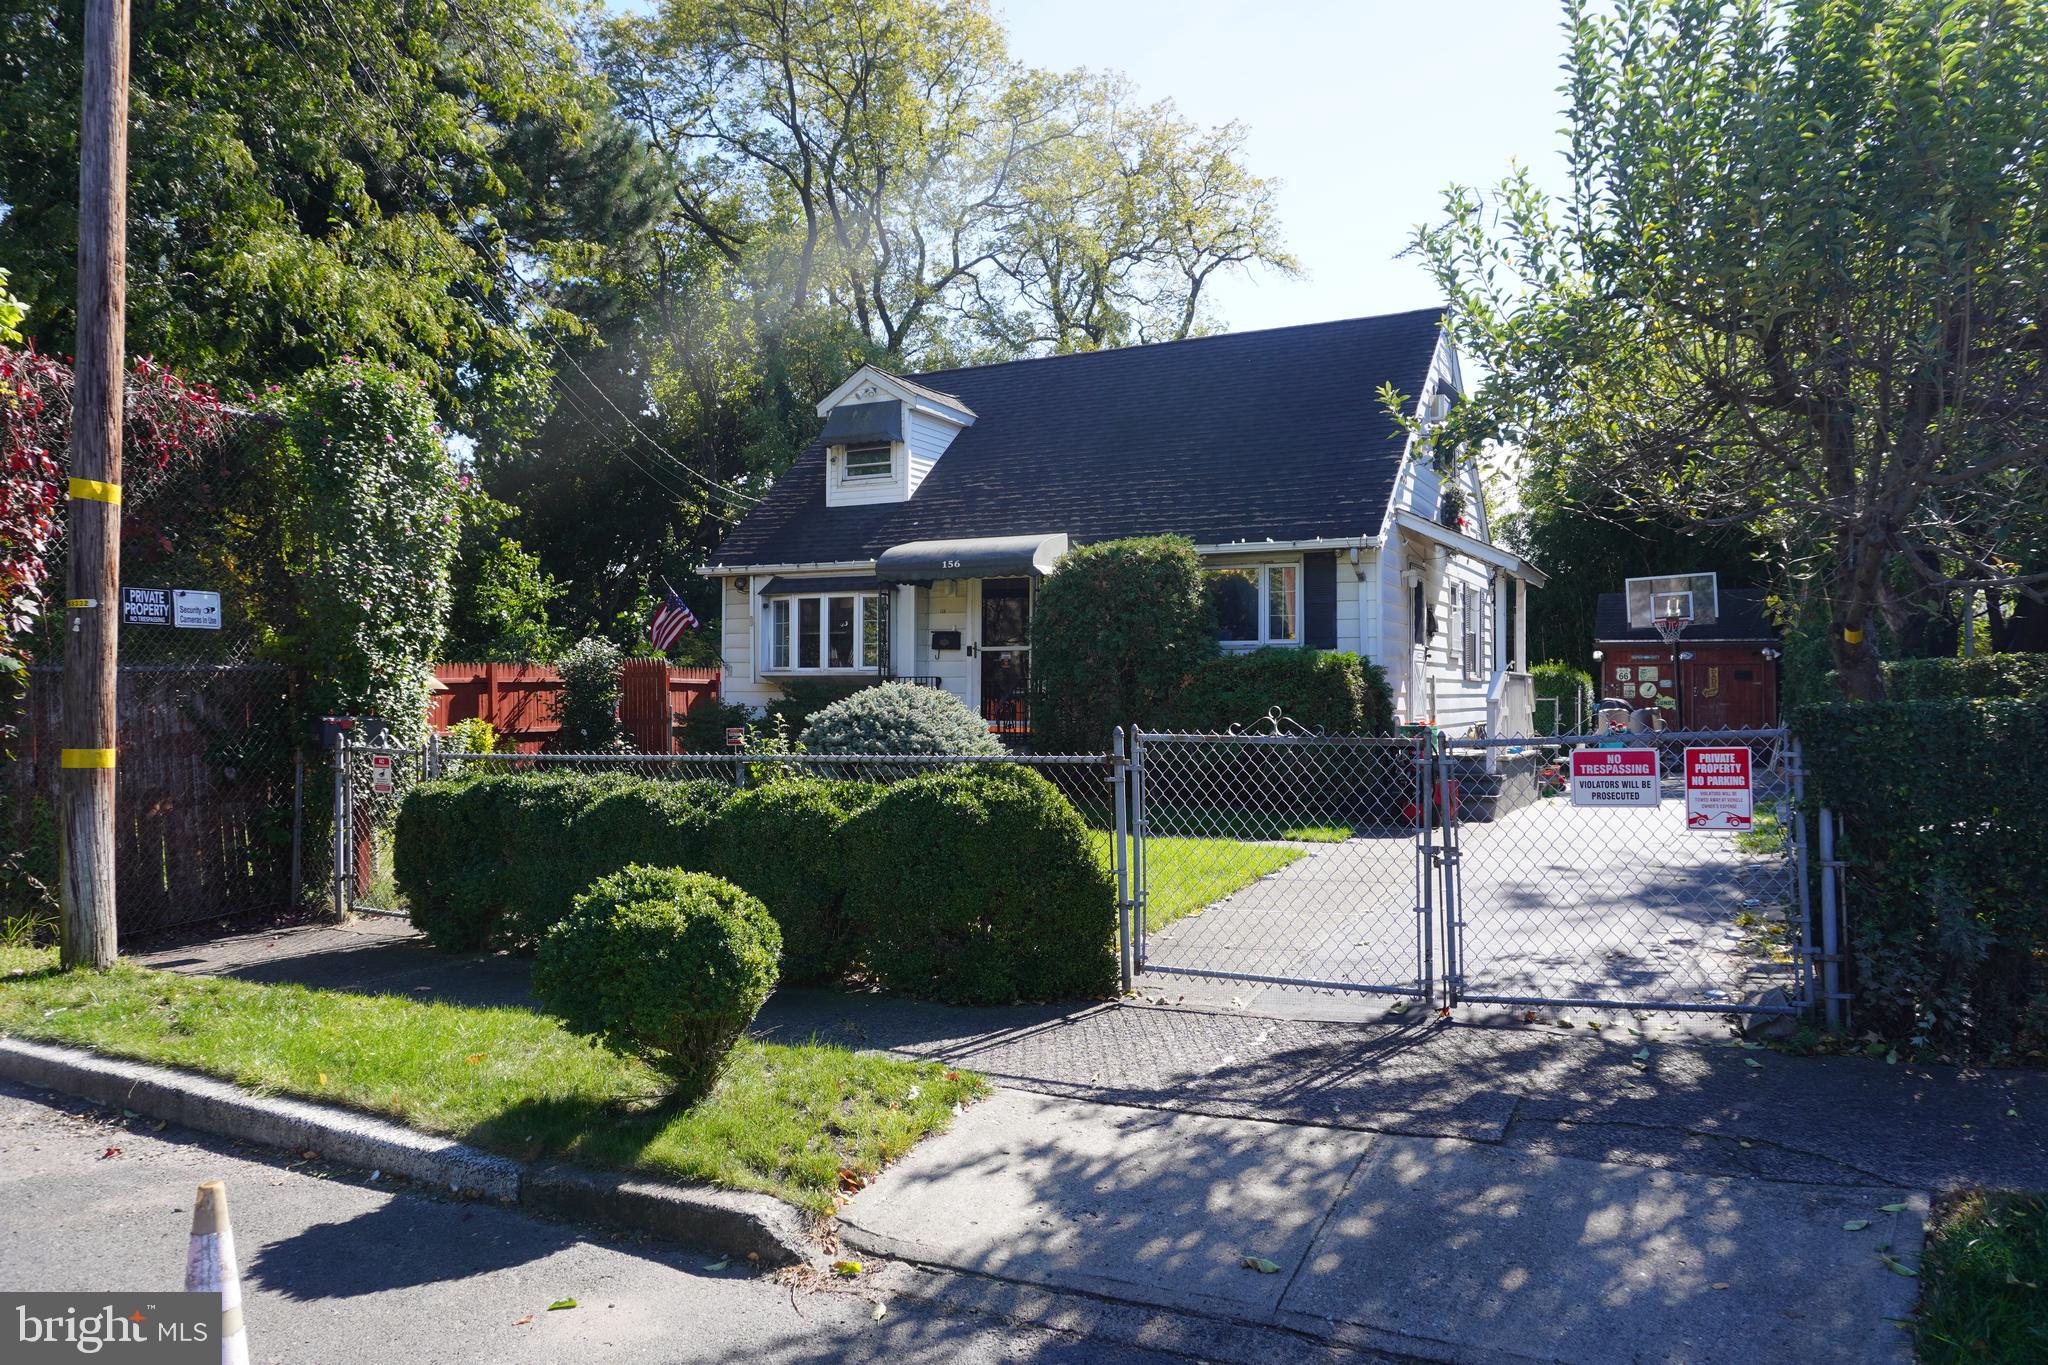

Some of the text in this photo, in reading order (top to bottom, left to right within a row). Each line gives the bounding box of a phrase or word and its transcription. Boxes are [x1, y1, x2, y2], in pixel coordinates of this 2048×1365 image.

[942, 560, 961, 569] 156
[129, 589, 165, 604] PRIVATE
[125, 602, 170, 617] PROPERTY
[179, 605, 202, 615] Security
[179, 615, 202, 624] Cameras
[208, 617, 217, 625] Use
[1618, 672, 1629, 680] 66
[1606, 754, 1622, 764] NO
[1699, 753, 1736, 763] PRIVATE
[1580, 764, 1650, 774] TRESPASSING
[1694, 763, 1742, 774] PROPERTY
[1579, 780, 1652, 789] VIOLATORS WILL BE
[1691, 775, 1746, 786] NO PARKING
[1591, 791, 1640, 801] PROSECUTED
